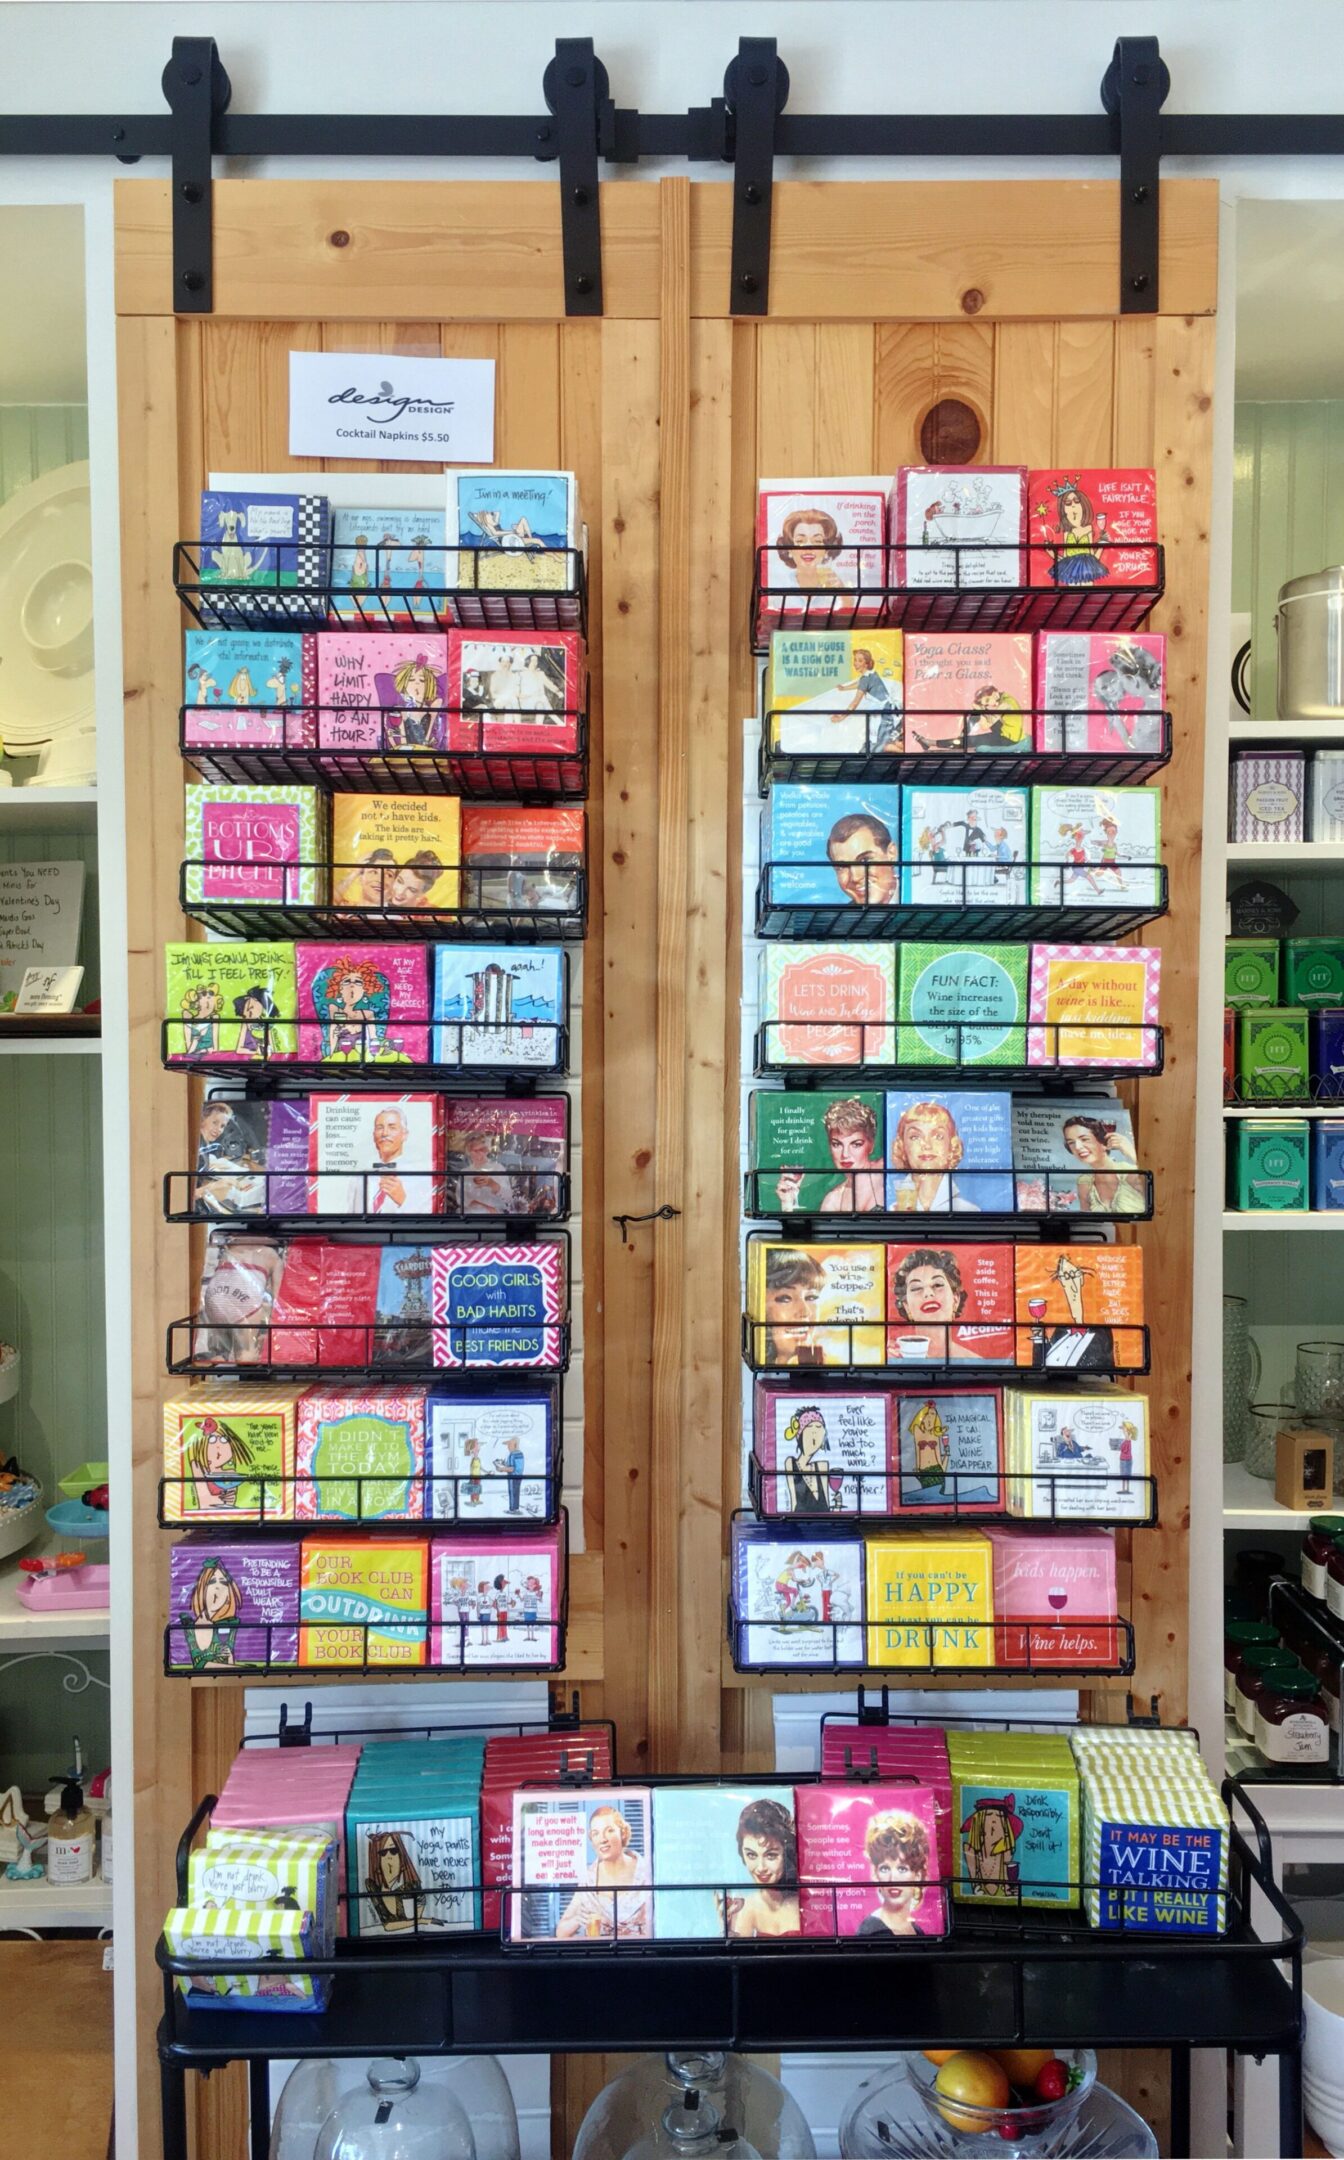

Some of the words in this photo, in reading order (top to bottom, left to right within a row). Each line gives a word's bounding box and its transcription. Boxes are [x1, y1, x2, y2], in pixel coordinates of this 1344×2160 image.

[328, 387, 455, 423] design
[408, 406, 452, 414] DESIGN
[336, 428, 376, 440] Cocktail
[379, 430, 419, 443] Napkins
[422, 432, 449, 443] $5.50
[948, 643, 992, 656] Class?
[336, 655, 364, 671] WHY
[334, 674, 368, 686] LIMIT
[330, 693, 372, 706] HAPPY
[335, 711, 348, 723] TO
[351, 712, 369, 725] AN
[330, 727, 376, 742] HOUR?
[372, 801, 387, 811] We
[390, 801, 427, 811] decided
[361, 812, 378, 820] not
[392, 813, 415, 822] have
[418, 812, 441, 823] kids.
[208, 821, 295, 839] BOTTOMS
[375, 824, 390, 833] The
[359, 833, 384, 842] taking
[395, 835, 418, 844] pretty
[420, 834, 442, 842] hard.
[932, 976, 958, 987] FUN
[964, 976, 999, 988] FACT:
[1057, 979, 1065, 989] A
[1069, 979, 1089, 992] day
[1092, 980, 1138, 992] without
[794, 985, 825, 997] LET'S
[831, 984, 869, 997] DRINK
[928, 992, 953, 1002] Wine
[956, 992, 1003, 1002] increases
[1056, 996, 1084, 1006] wine
[1088, 996, 1097, 1006] is
[789, 1003, 816, 1016] Wine
[930, 1007, 944, 1016] the
[948, 1008, 966, 1016] size
[969, 1007, 980, 1016] of
[983, 1007, 998, 1016] the
[945, 1035, 956, 1045] by
[326, 1107, 359, 1116] Drinking
[785, 1107, 805, 1116] finally
[787, 1117, 815, 1126] drinking
[830, 1264, 849, 1272] You
[978, 1259, 994, 1268] Step
[452, 1274, 498, 1287] GOOD
[502, 1274, 540, 1286] GIRLS
[486, 1288, 506, 1300] with
[984, 1299, 995, 1308] job
[457, 1306, 486, 1319] BAD
[490, 1305, 536, 1317] HABITS
[835, 1306, 864, 1314] That's
[488, 1339, 539, 1351] FRIENDS
[241, 1558, 291, 1569] PRETENDING
[316, 1556, 352, 1569] OUR
[250, 1568, 259, 1577] TO
[260, 1568, 272, 1577] BE
[316, 1572, 362, 1584] BOOK
[369, 1571, 413, 1584] CLUB
[908, 1572, 925, 1581] you
[928, 1570, 952, 1579] can't
[1014, 1562, 1046, 1578] Kids
[1050, 1562, 1100, 1583] happen.
[241, 1577, 293, 1587] RESPONSIBLE
[246, 1587, 272, 1597] ADULT
[380, 1588, 413, 1600] CAN
[885, 1583, 978, 1602] HAPPY
[252, 1597, 284, 1606] WEARS
[307, 1595, 421, 1636] OUTDRINK
[316, 1630, 365, 1642] YOUR
[886, 1629, 980, 1649] DRUNK
[1019, 1634, 1055, 1650] Wine
[1059, 1634, 1098, 1654] helps.
[315, 1646, 361, 1659] BOOK
[366, 1646, 412, 1658] CLUB
[536, 1816, 543, 1825] if
[562, 1816, 577, 1825] wait
[528, 1827, 544, 1837] long
[546, 1827, 574, 1837] enough
[576, 1828, 585, 1836] to
[490, 1835, 511, 1844] with
[1110, 1830, 1122, 1841] IT
[1128, 1832, 1156, 1844] MAY
[1162, 1834, 1180, 1846] BE
[1186, 1836, 1211, 1847] THE
[417, 1839, 444, 1857] yoga
[446, 1838, 470, 1851] pants
[538, 1849, 574, 1859] everyone
[1108, 1844, 1211, 1874] WINE
[418, 1854, 441, 1869] have
[443, 1857, 470, 1867] never
[556, 1860, 572, 1869] just
[432, 1870, 456, 1882] been
[1108, 1869, 1211, 1890] TALKING.
[434, 1891, 466, 1909] yoga!
[1154, 1892, 1209, 1907] REALLY
[1108, 1905, 1148, 1922] LIKE
[1155, 1908, 1208, 1925] WINE
